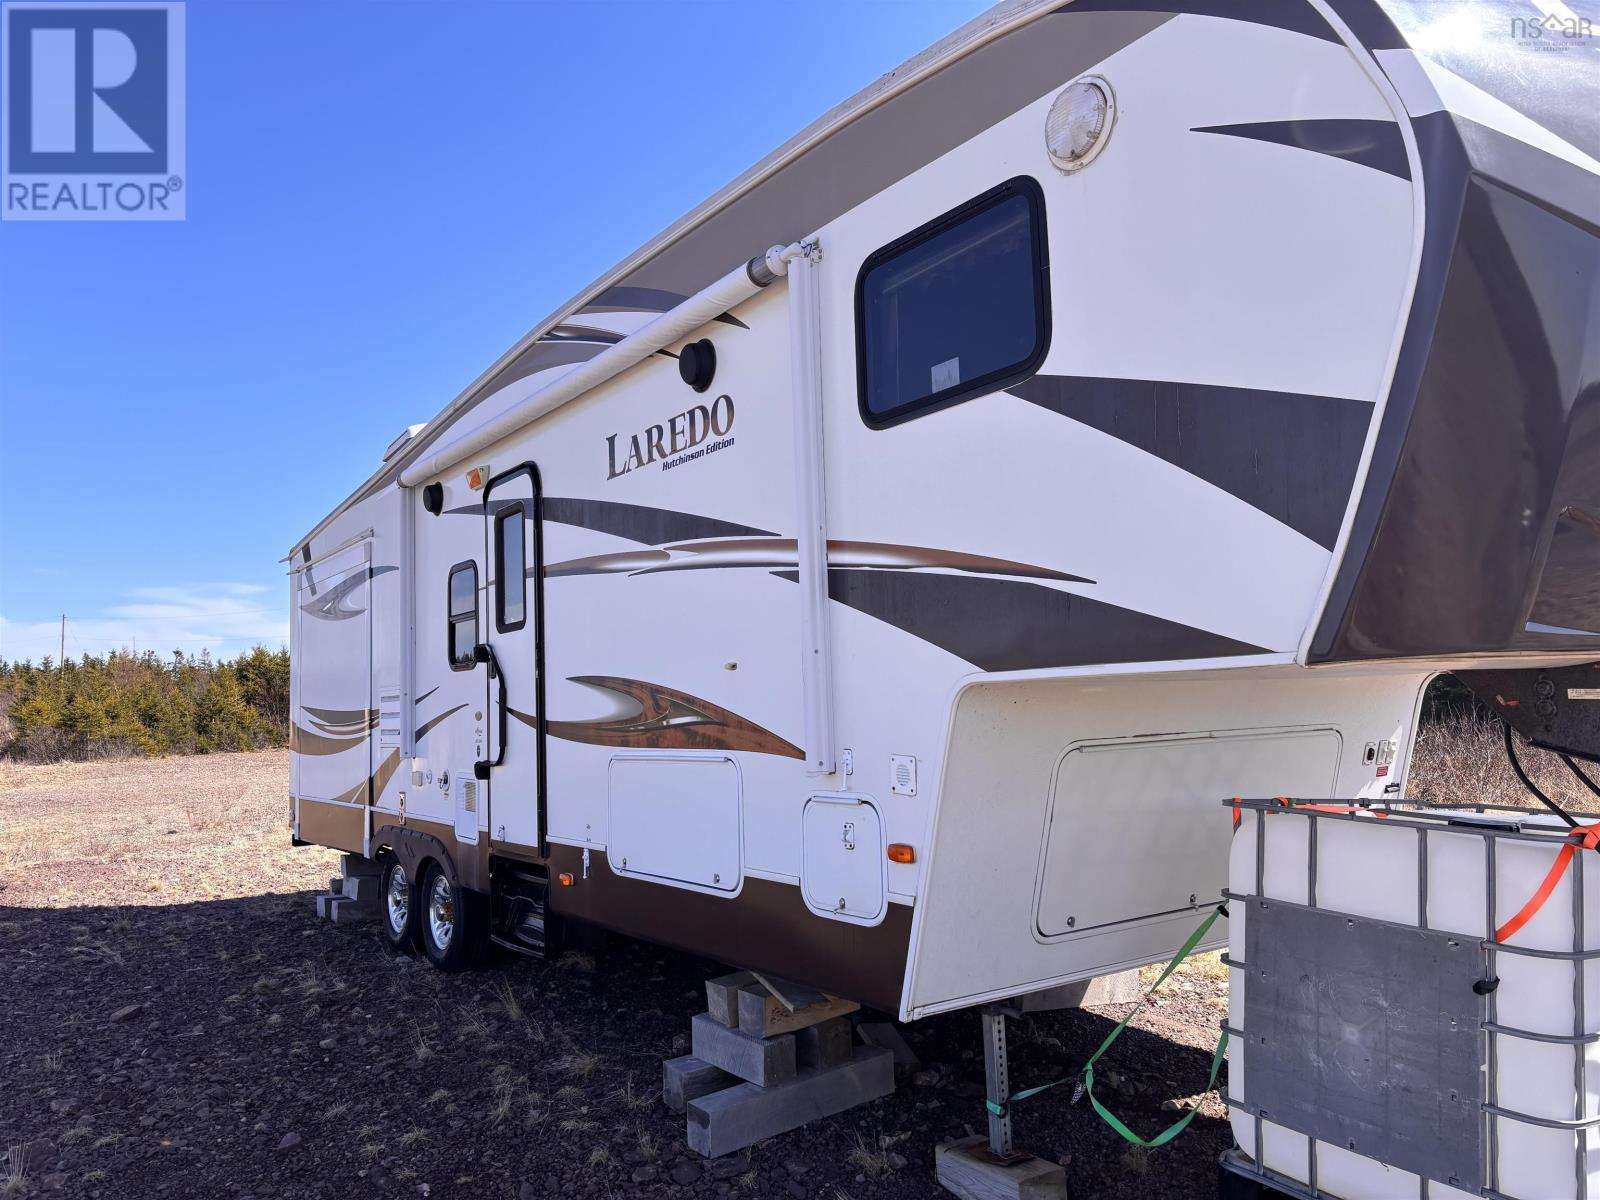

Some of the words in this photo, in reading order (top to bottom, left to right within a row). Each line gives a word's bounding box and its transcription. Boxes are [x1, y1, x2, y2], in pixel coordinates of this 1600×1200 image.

[605, 394, 735, 480] LAREDO
[662, 448, 705, 471] Hutchinson
[705, 437, 735, 455] Edition
